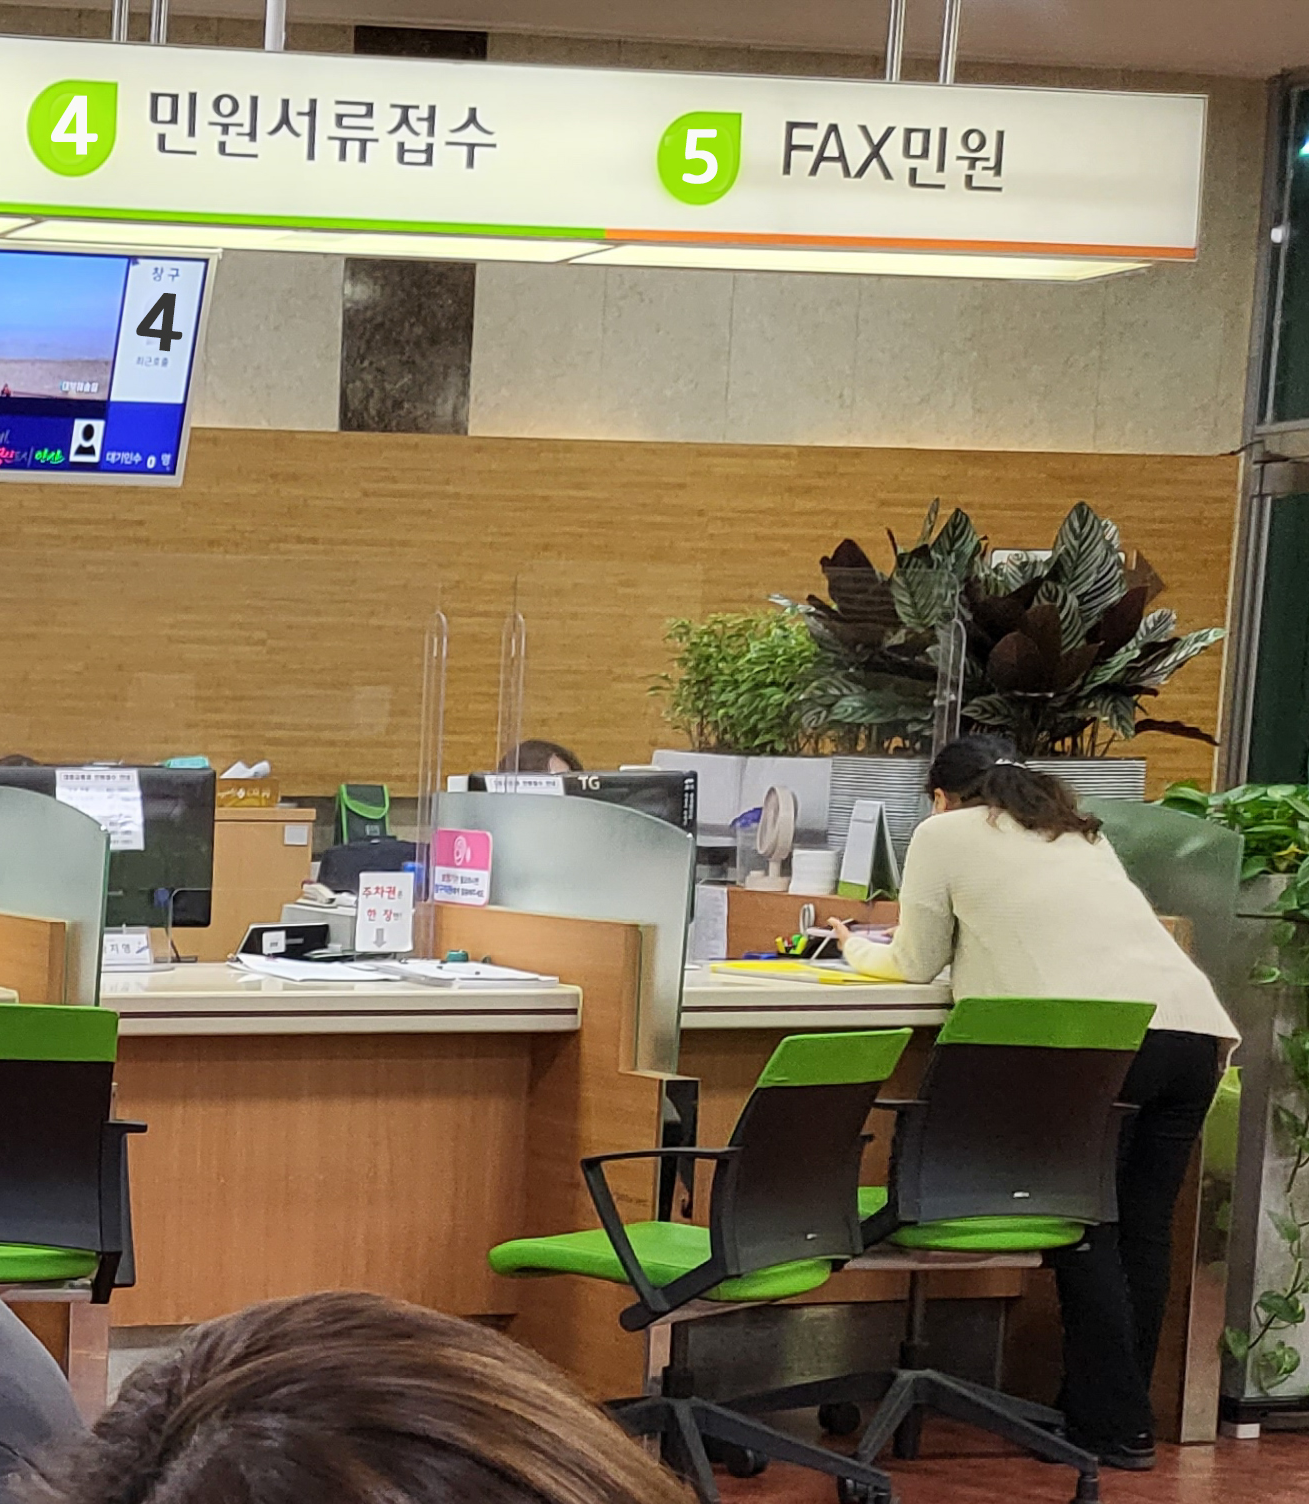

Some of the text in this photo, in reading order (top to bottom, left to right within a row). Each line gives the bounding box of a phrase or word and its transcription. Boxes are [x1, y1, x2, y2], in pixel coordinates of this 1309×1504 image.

[51, 90, 498, 171] 4 민원서류접수
[681, 119, 1006, 194] 5 FAX민원
[136, 293, 182, 351] 4
[106, 450, 170, 469] 대기인수 0 명
[578, 776, 600, 790] TG
